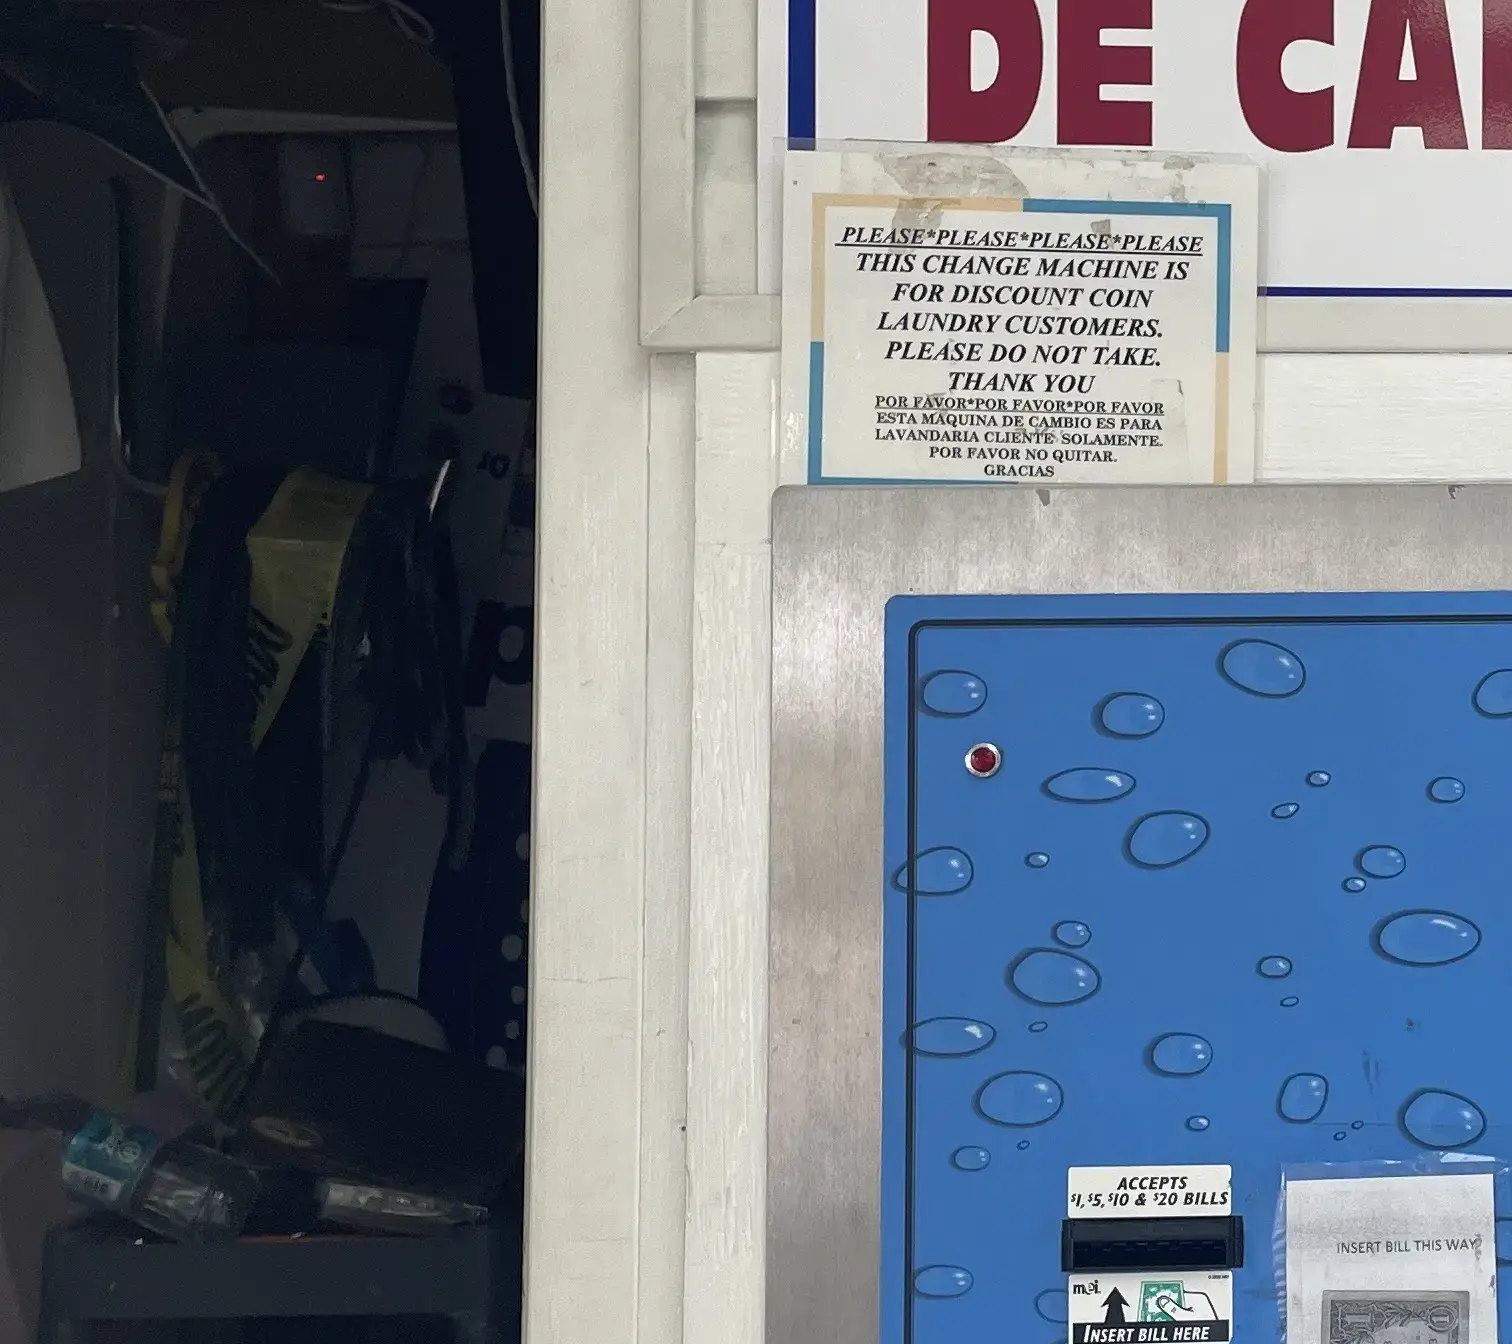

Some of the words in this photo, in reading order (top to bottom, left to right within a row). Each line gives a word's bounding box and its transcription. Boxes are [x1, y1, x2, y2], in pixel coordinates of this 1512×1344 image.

[856, 252, 916, 274] THIS
[922, 255, 1029, 277] CHANGE
[1036, 258, 1158, 279] MACHINE
[1163, 262, 1189, 280] IS
[891, 283, 944, 303] FOR
[951, 285, 1083, 306] DISCOUNT
[1089, 288, 1153, 308] COIN
[876, 311, 1001, 334] LAUNDRY
[1005, 315, 1163, 338] CUSTOMERS.
[885, 341, 981, 363] PLEASE
[988, 344, 1026, 363] DO
[1032, 346, 1085, 365] NOT
[1089, 347, 1161, 367] TAKE.
[948, 372, 1036, 392] THANK
[1044, 374, 1096, 394] YOU
[875, 396, 908, 410] POR
[1111, 401, 1164, 414] FAVOR
[876, 413, 917, 424] ESTA
[921, 413, 998, 428] MAQUINA
[1002, 415, 1024, 427] DE
[1029, 416, 1093, 429] CAMBIO
[1096, 418, 1115, 430] ES
[1120, 419, 1162, 431] PARA
[875, 430, 979, 443] LAVANDARIA
[984, 431, 1054, 444] CLIENTE
[1062, 433, 1163, 447] SOLAMENTE.
[929, 447, 962, 459] POR
[967, 448, 1021, 460] FAVOR
[1025, 449, 1048, 461] NO
[1053, 450, 1118, 463] QUITAR.
[984, 464, 1054, 477] GRACIAS
[1117, 1177, 1188, 1190] ACCEPTS
[1135, 1193, 1146, 1206] &
[1153, 1193, 1178, 1205] $20
[1184, 1192, 1228, 1205] BILLS
[1337, 1242, 1381, 1254] INSERT
[1386, 1241, 1411, 1252] BILL
[1415, 1240, 1441, 1251] THIS
[1446, 1239, 1476, 1250] WAY
[1138, 1328, 1168, 1341] BILL
[1174, 1326, 1210, 1340] HERE
